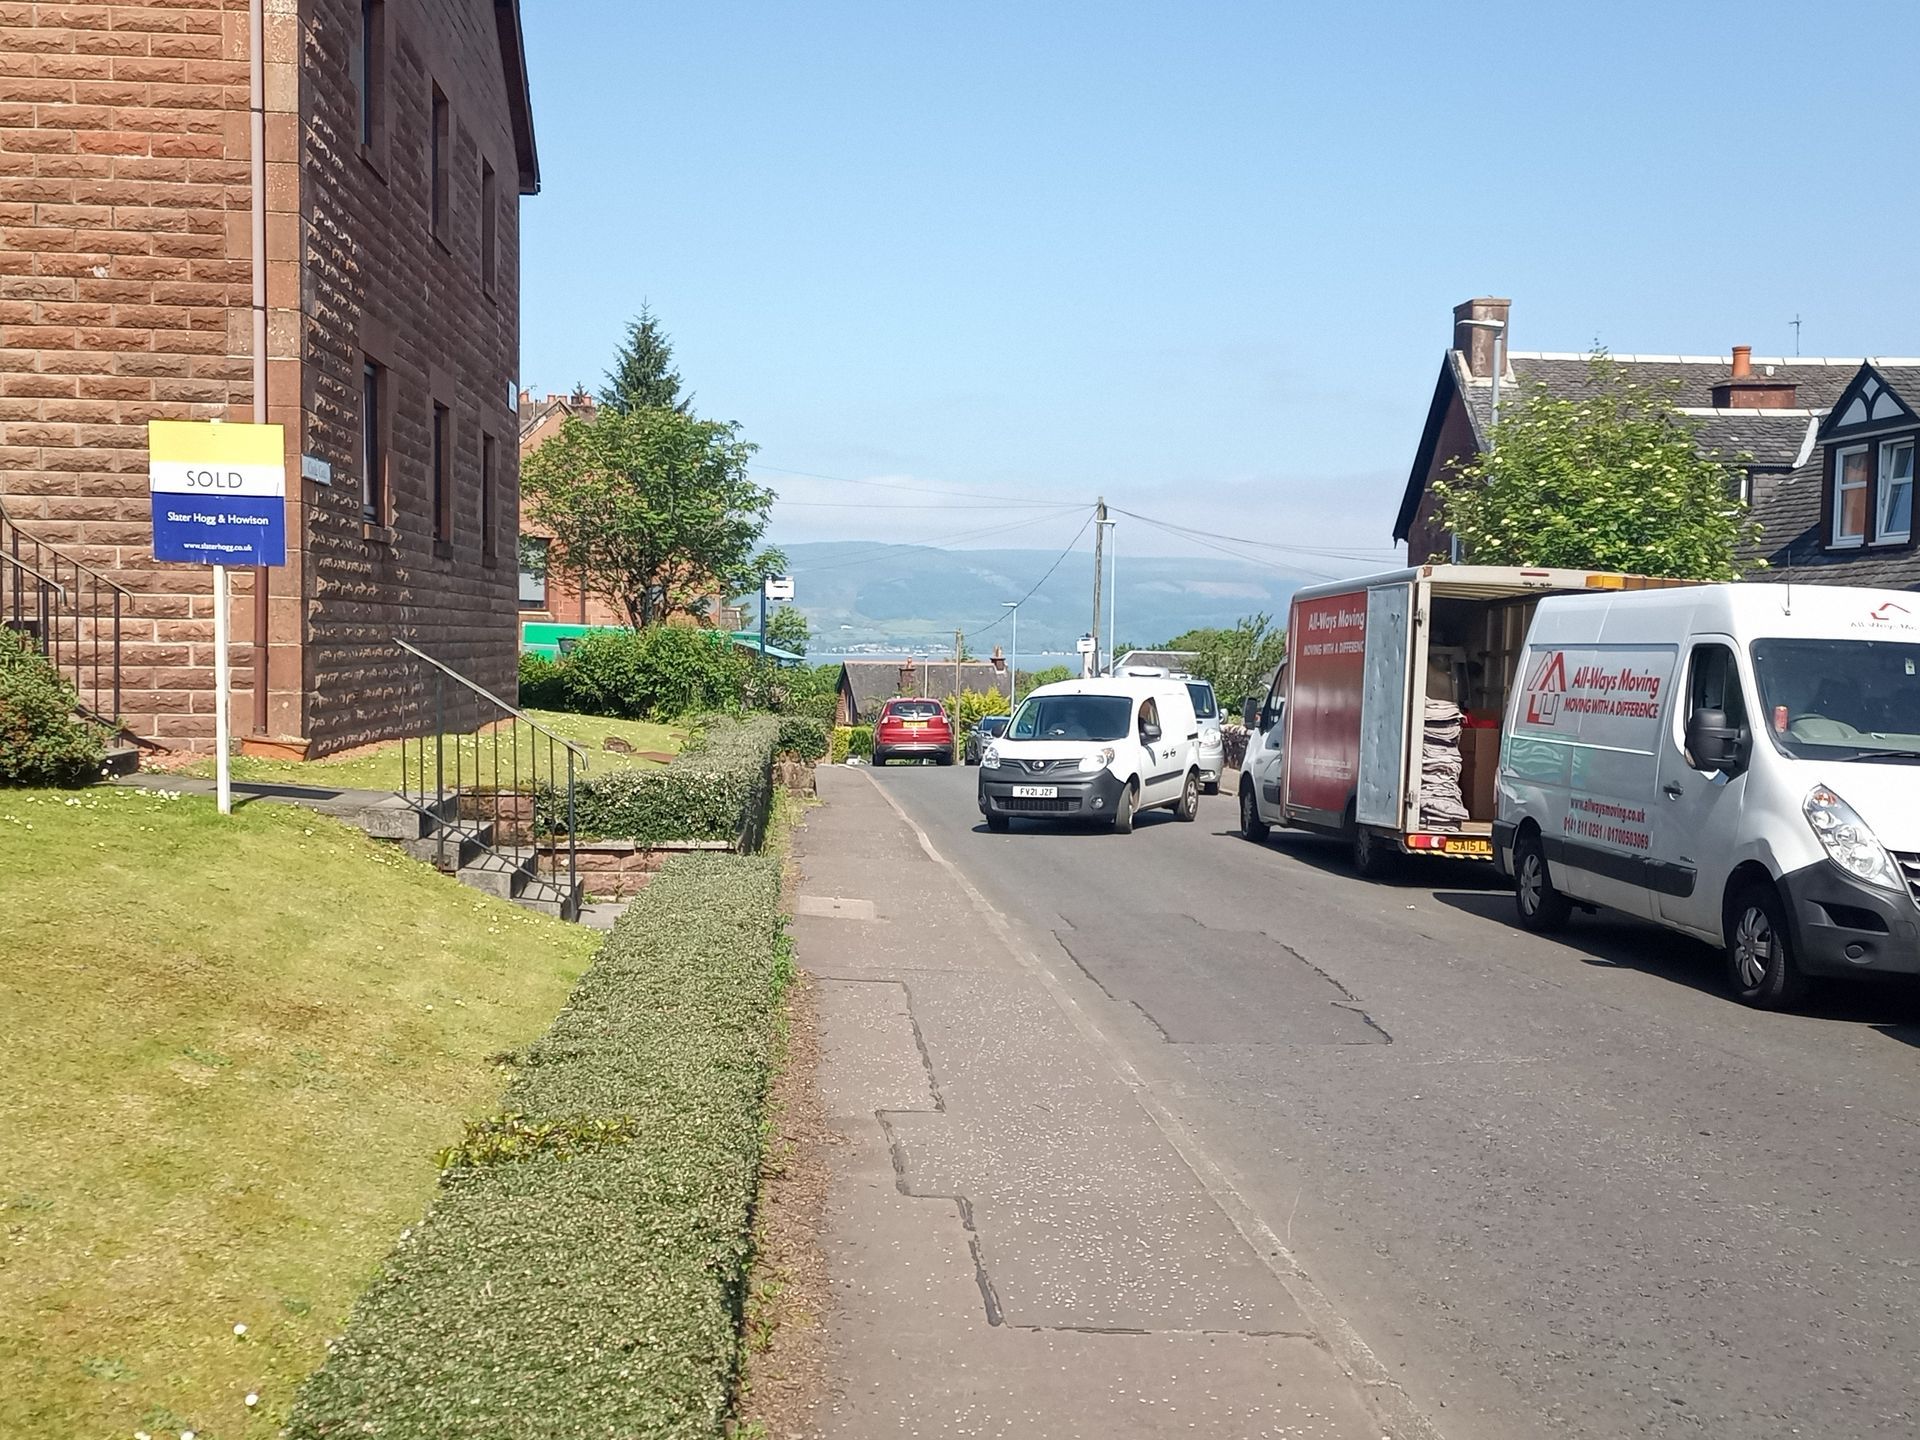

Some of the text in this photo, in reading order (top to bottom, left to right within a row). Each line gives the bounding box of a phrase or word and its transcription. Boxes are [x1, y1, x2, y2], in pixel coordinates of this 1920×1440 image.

[186, 470, 243, 488] SOLD
[167, 511, 269, 526] Slater Hogg & Howison
[183, 542, 253, 553] www.slaterhogg.co.uk
[1308, 607, 1365, 634] All-Ways Moving
[1303, 644, 1322, 656] MOVING
[1322, 642, 1335, 655] WITH
[1339, 640, 1364, 654] DIFFERENC
[1571, 666, 1661, 699] All-Ways Moving
[1563, 697, 1660, 719] MOVING WITH A DIFFERENCE
[1020, 787, 1054, 797] FV21 JZF
[1570, 798, 1646, 824] www.allwaysmoving.co.uk
[1452, 840, 1476, 851] SA15
